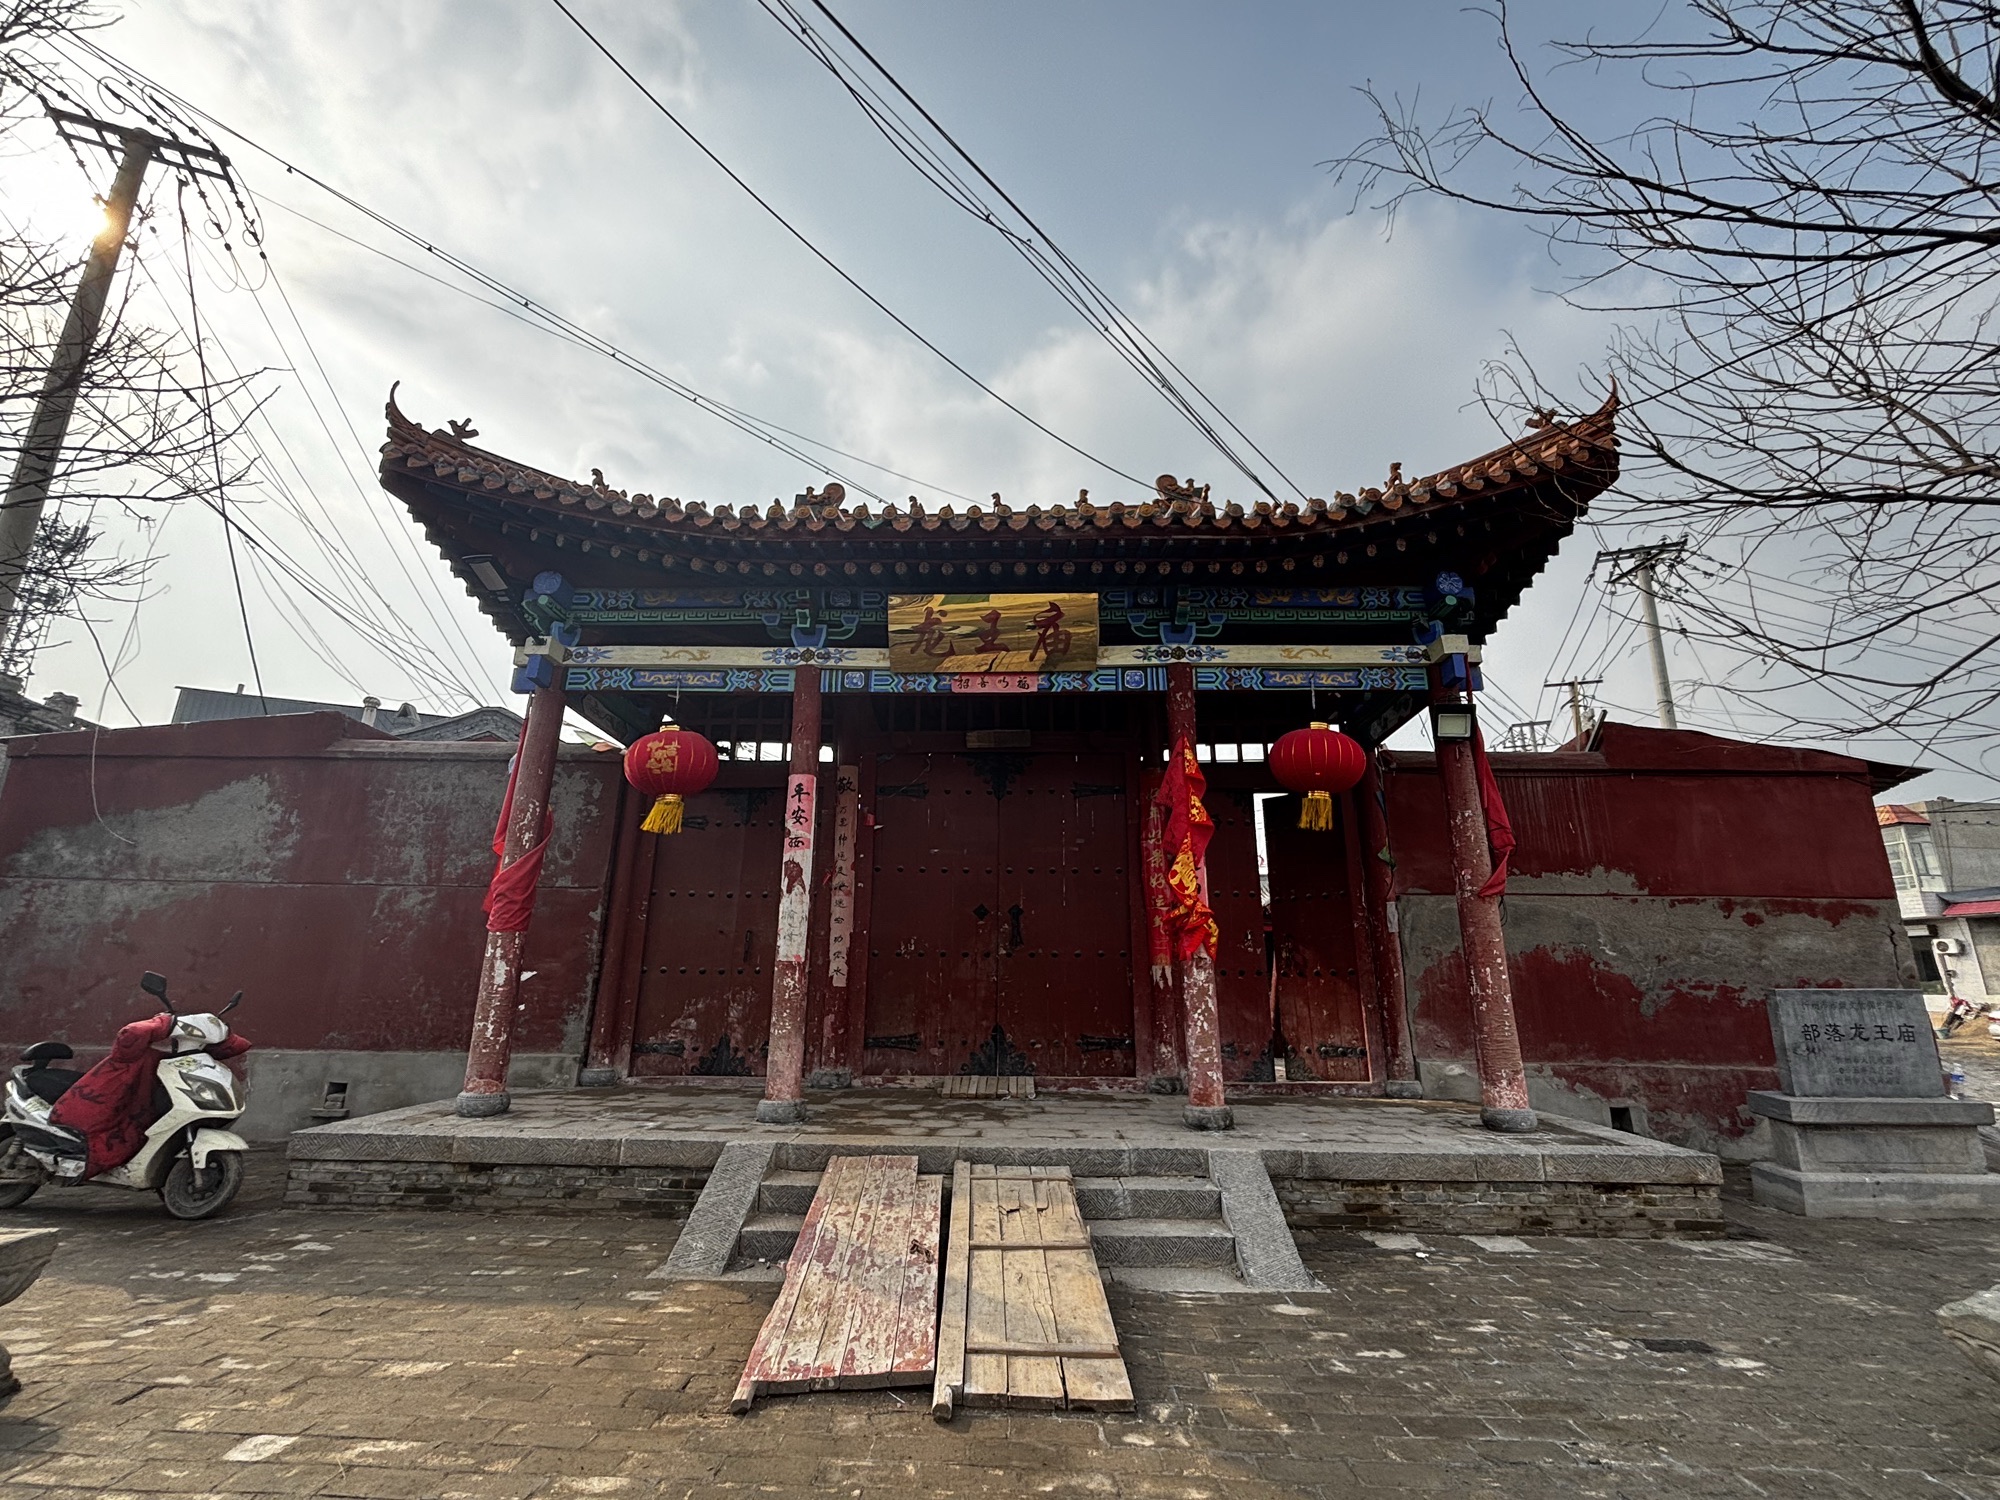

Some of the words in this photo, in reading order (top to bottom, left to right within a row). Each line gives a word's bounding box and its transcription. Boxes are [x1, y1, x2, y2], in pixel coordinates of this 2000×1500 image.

[909, 601, 1072, 662] 龙王庙
[1801, 1023, 1916, 1043] 部落龙王庙
